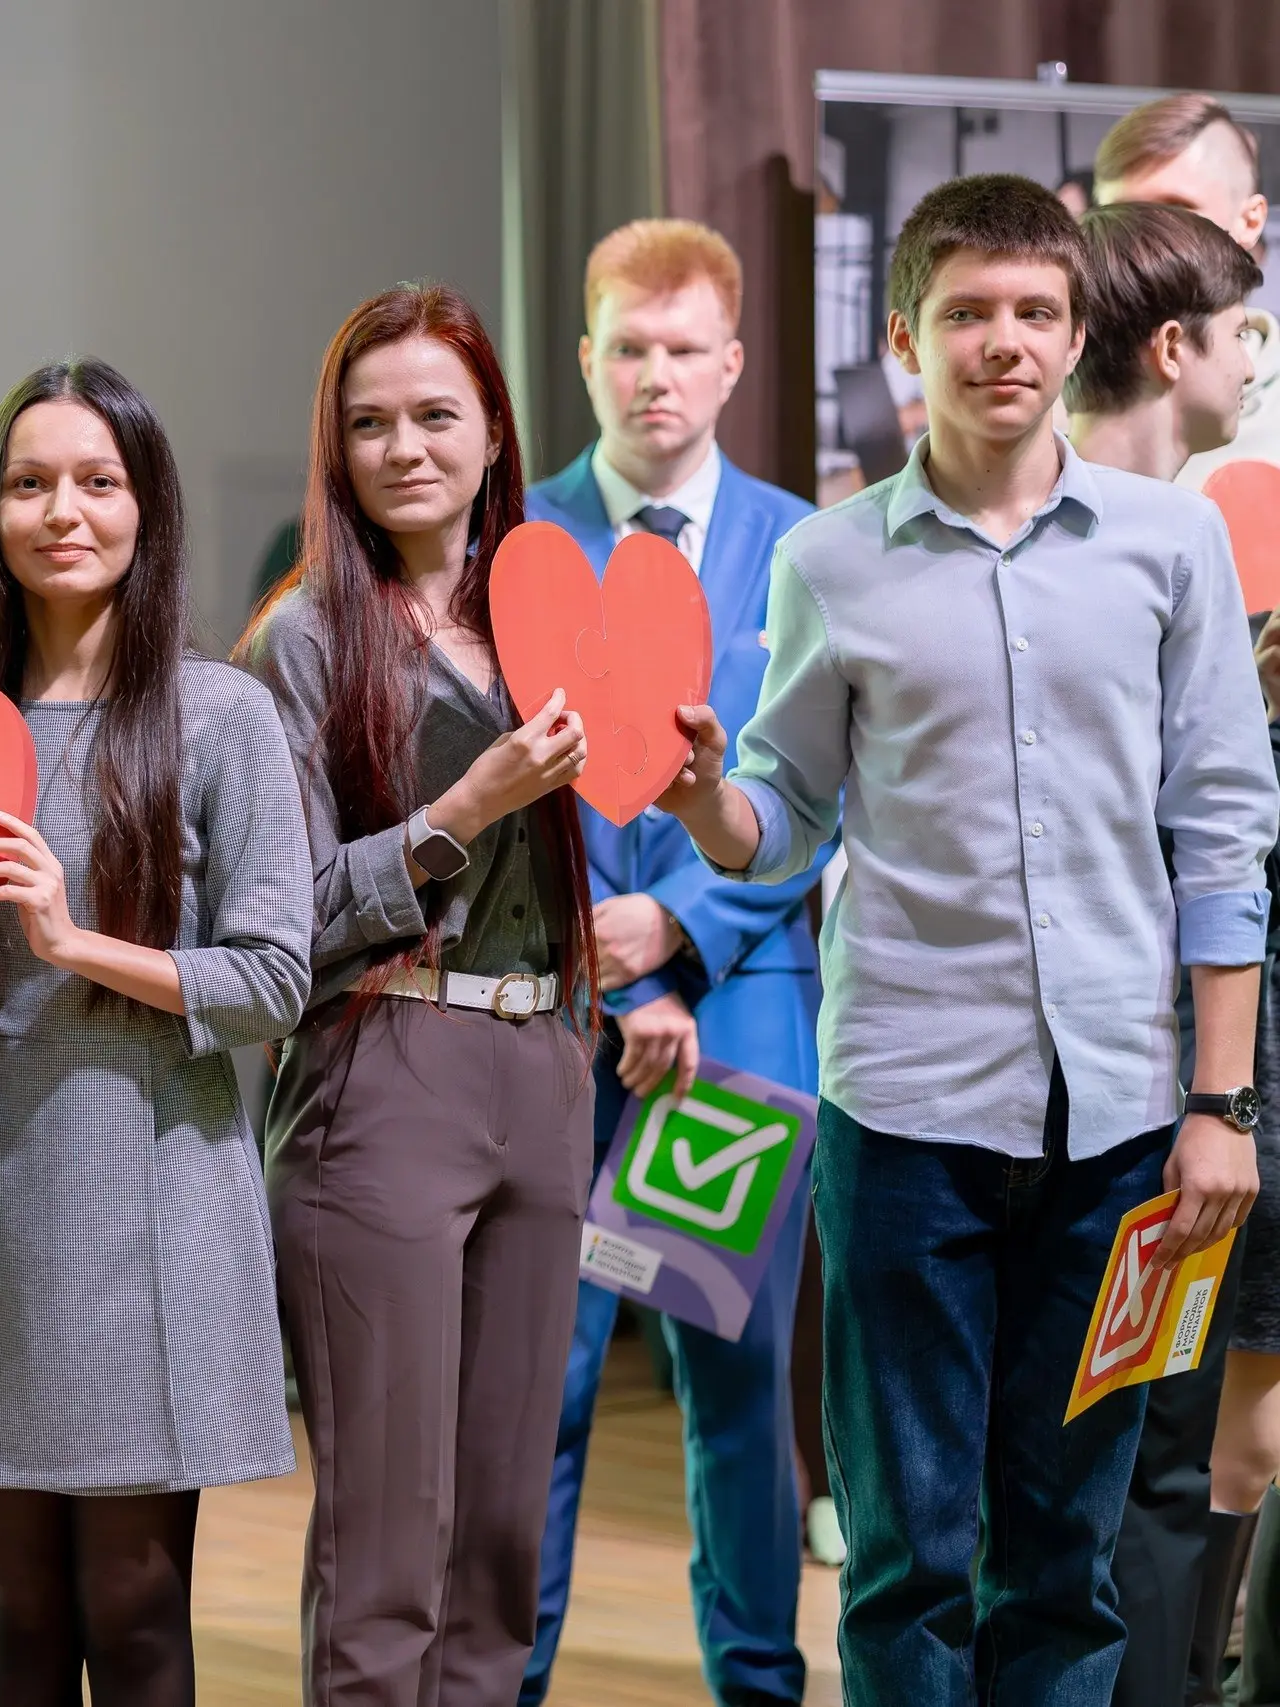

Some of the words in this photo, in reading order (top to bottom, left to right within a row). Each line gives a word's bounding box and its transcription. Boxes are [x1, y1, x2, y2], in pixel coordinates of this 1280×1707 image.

[1175, 1309, 1190, 1349] ФОРУМ
[1182, 1289, 1202, 1347] МОЛОДЫХ
[1188, 1288, 1209, 1346] ТАЛАНТОВ
